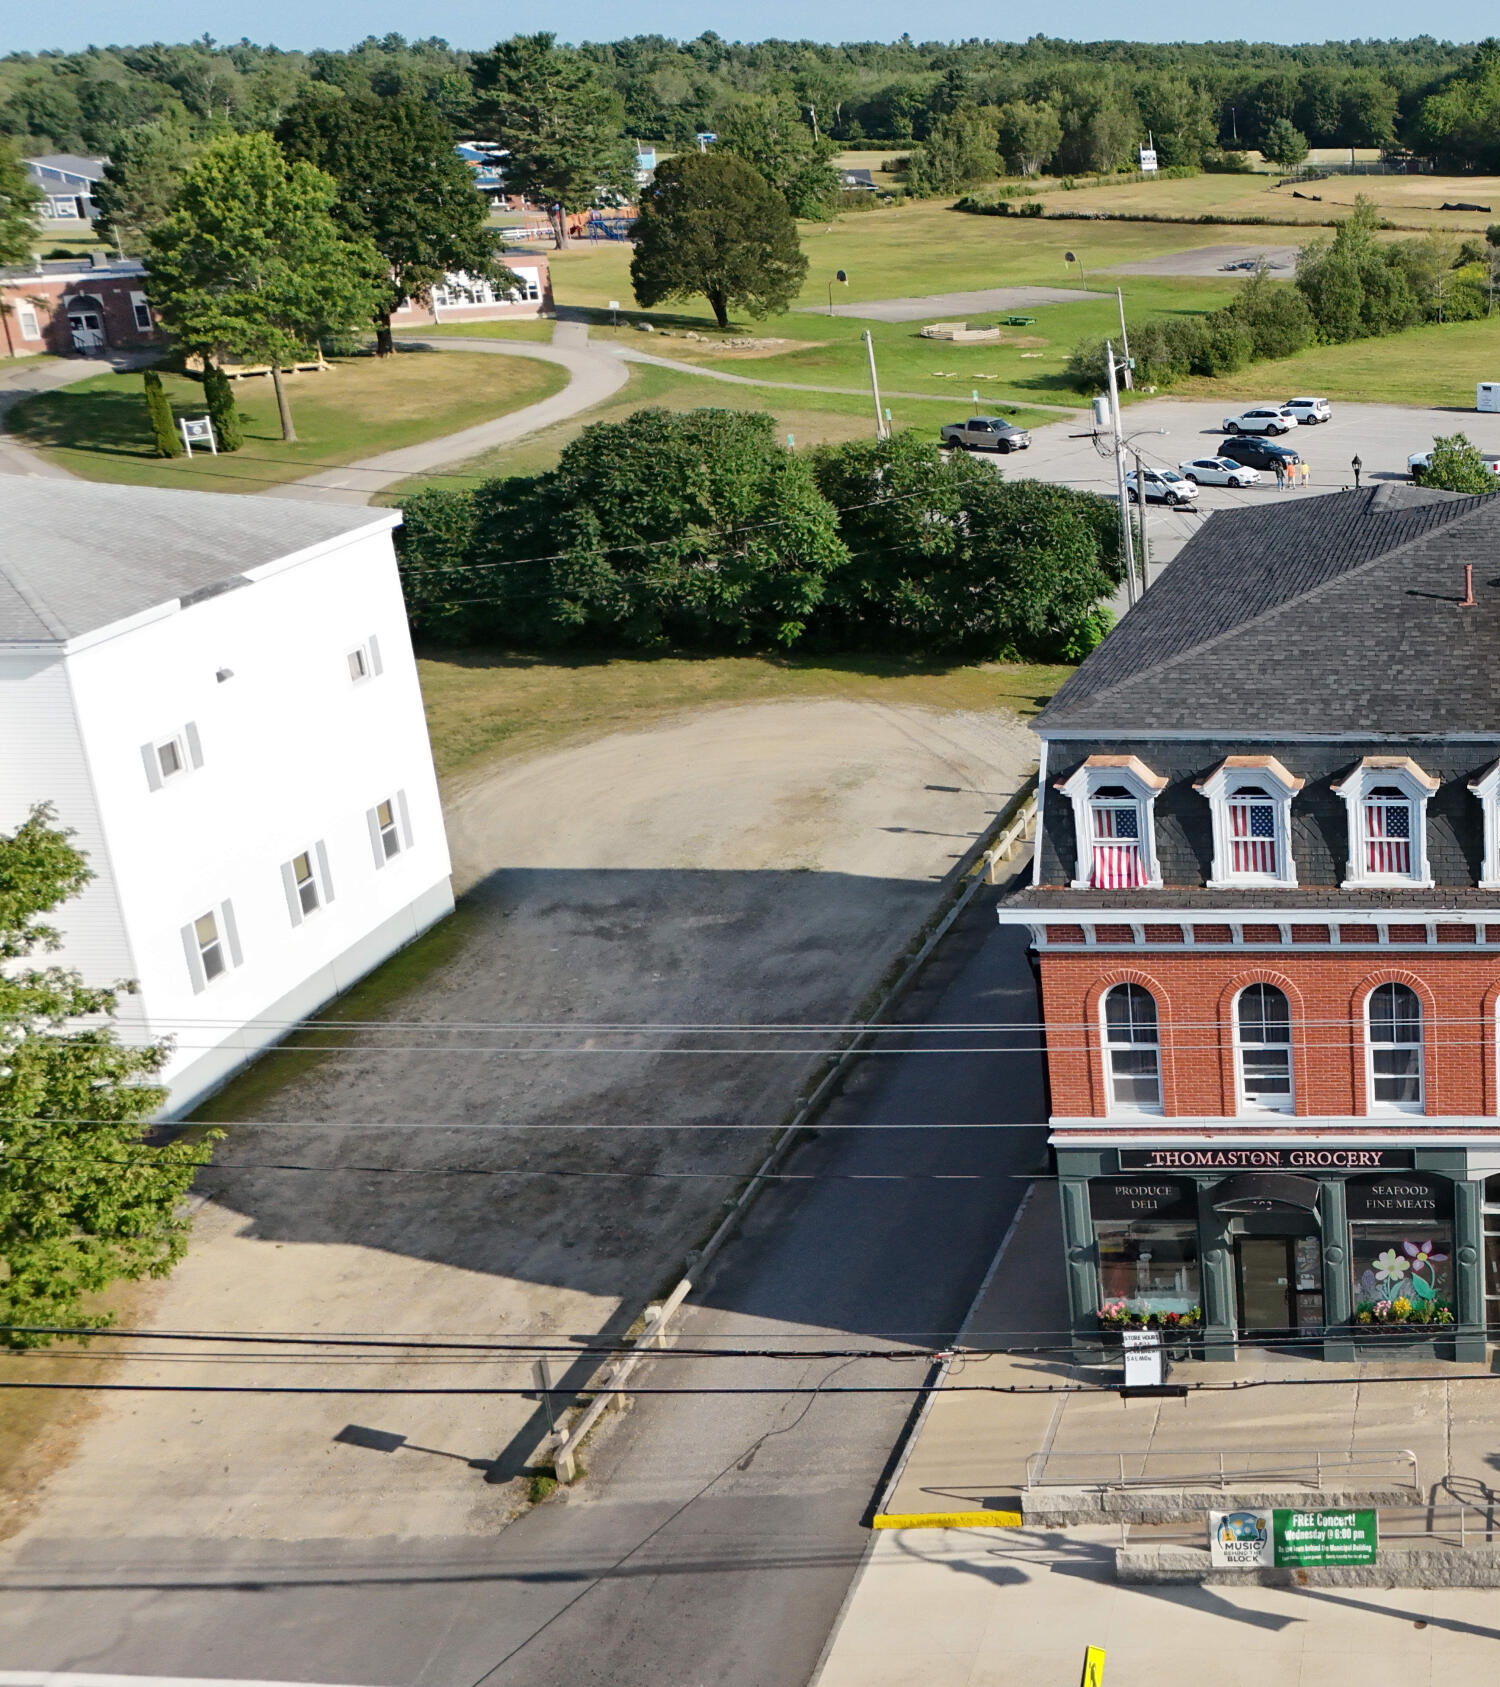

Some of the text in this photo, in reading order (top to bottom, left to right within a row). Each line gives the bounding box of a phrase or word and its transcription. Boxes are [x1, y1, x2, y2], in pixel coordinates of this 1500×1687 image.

[1151, 1151, 1383, 1167] THOMASTON GROCERY
[1115, 1186, 1172, 1197] PRODUCE
[1371, 1185, 1429, 1196] SEAFOOD
[1130, 1200, 1158, 1209] DELI
[1366, 1199, 1436, 1209] FINE MEATS
[1292, 1513, 1356, 1527] FREE Concert!
[1284, 1529, 1326, 1542] Wednesday
[1353, 1530, 1365, 1541] pm
[1225, 1542, 1261, 1550] MUSIC
